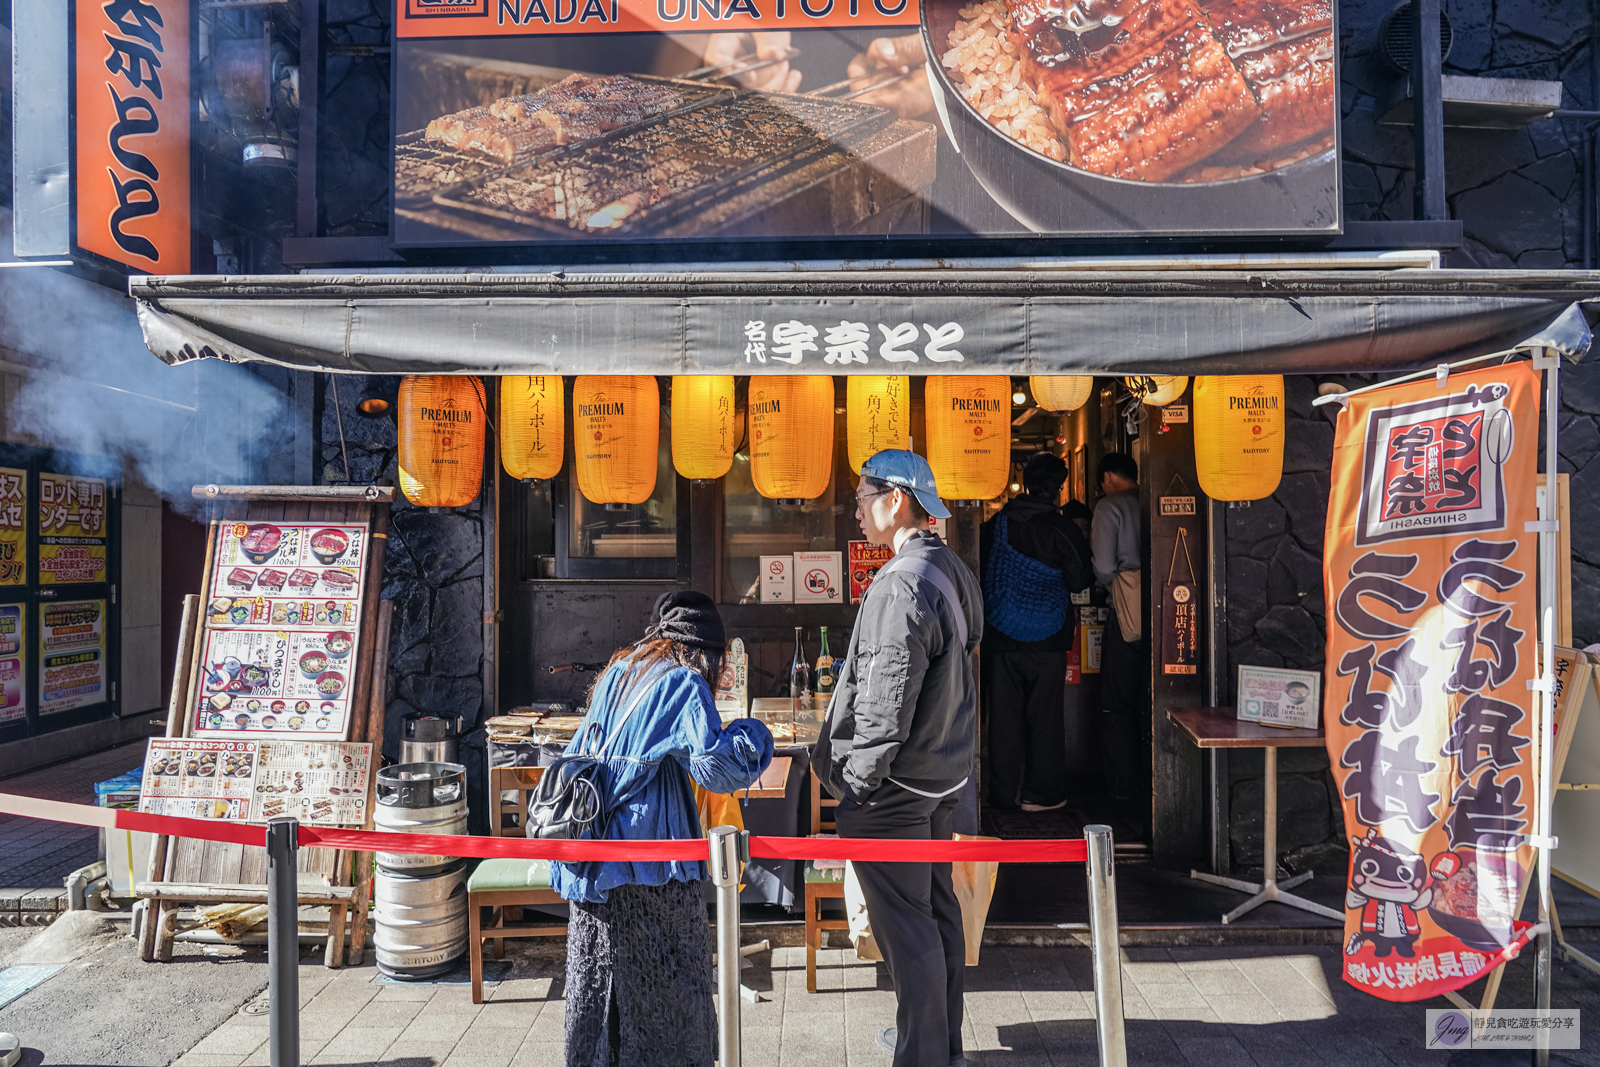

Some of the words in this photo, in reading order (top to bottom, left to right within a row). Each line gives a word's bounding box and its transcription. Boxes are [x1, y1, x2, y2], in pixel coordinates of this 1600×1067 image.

[744, 319, 767, 364] 名代
[771, 320, 966, 365] 宇奈とと
[421, 407, 472, 423] PREMIUM
[578, 402, 624, 418] PREMIUM
[952, 397, 1000, 412] PREMIUM
[1229, 396, 1278, 410] PREMIUM
[41, 480, 103, 507] ロット専門
[40, 506, 103, 530] ンターです
[1164, 504, 1192, 512] OPEN
[288, 528, 300, 556] うな丼
[350, 530, 360, 558] うな丼
[1175, 604, 1188, 663] 頂店ハイボール
[272, 640, 286, 688] ひつまぶし
